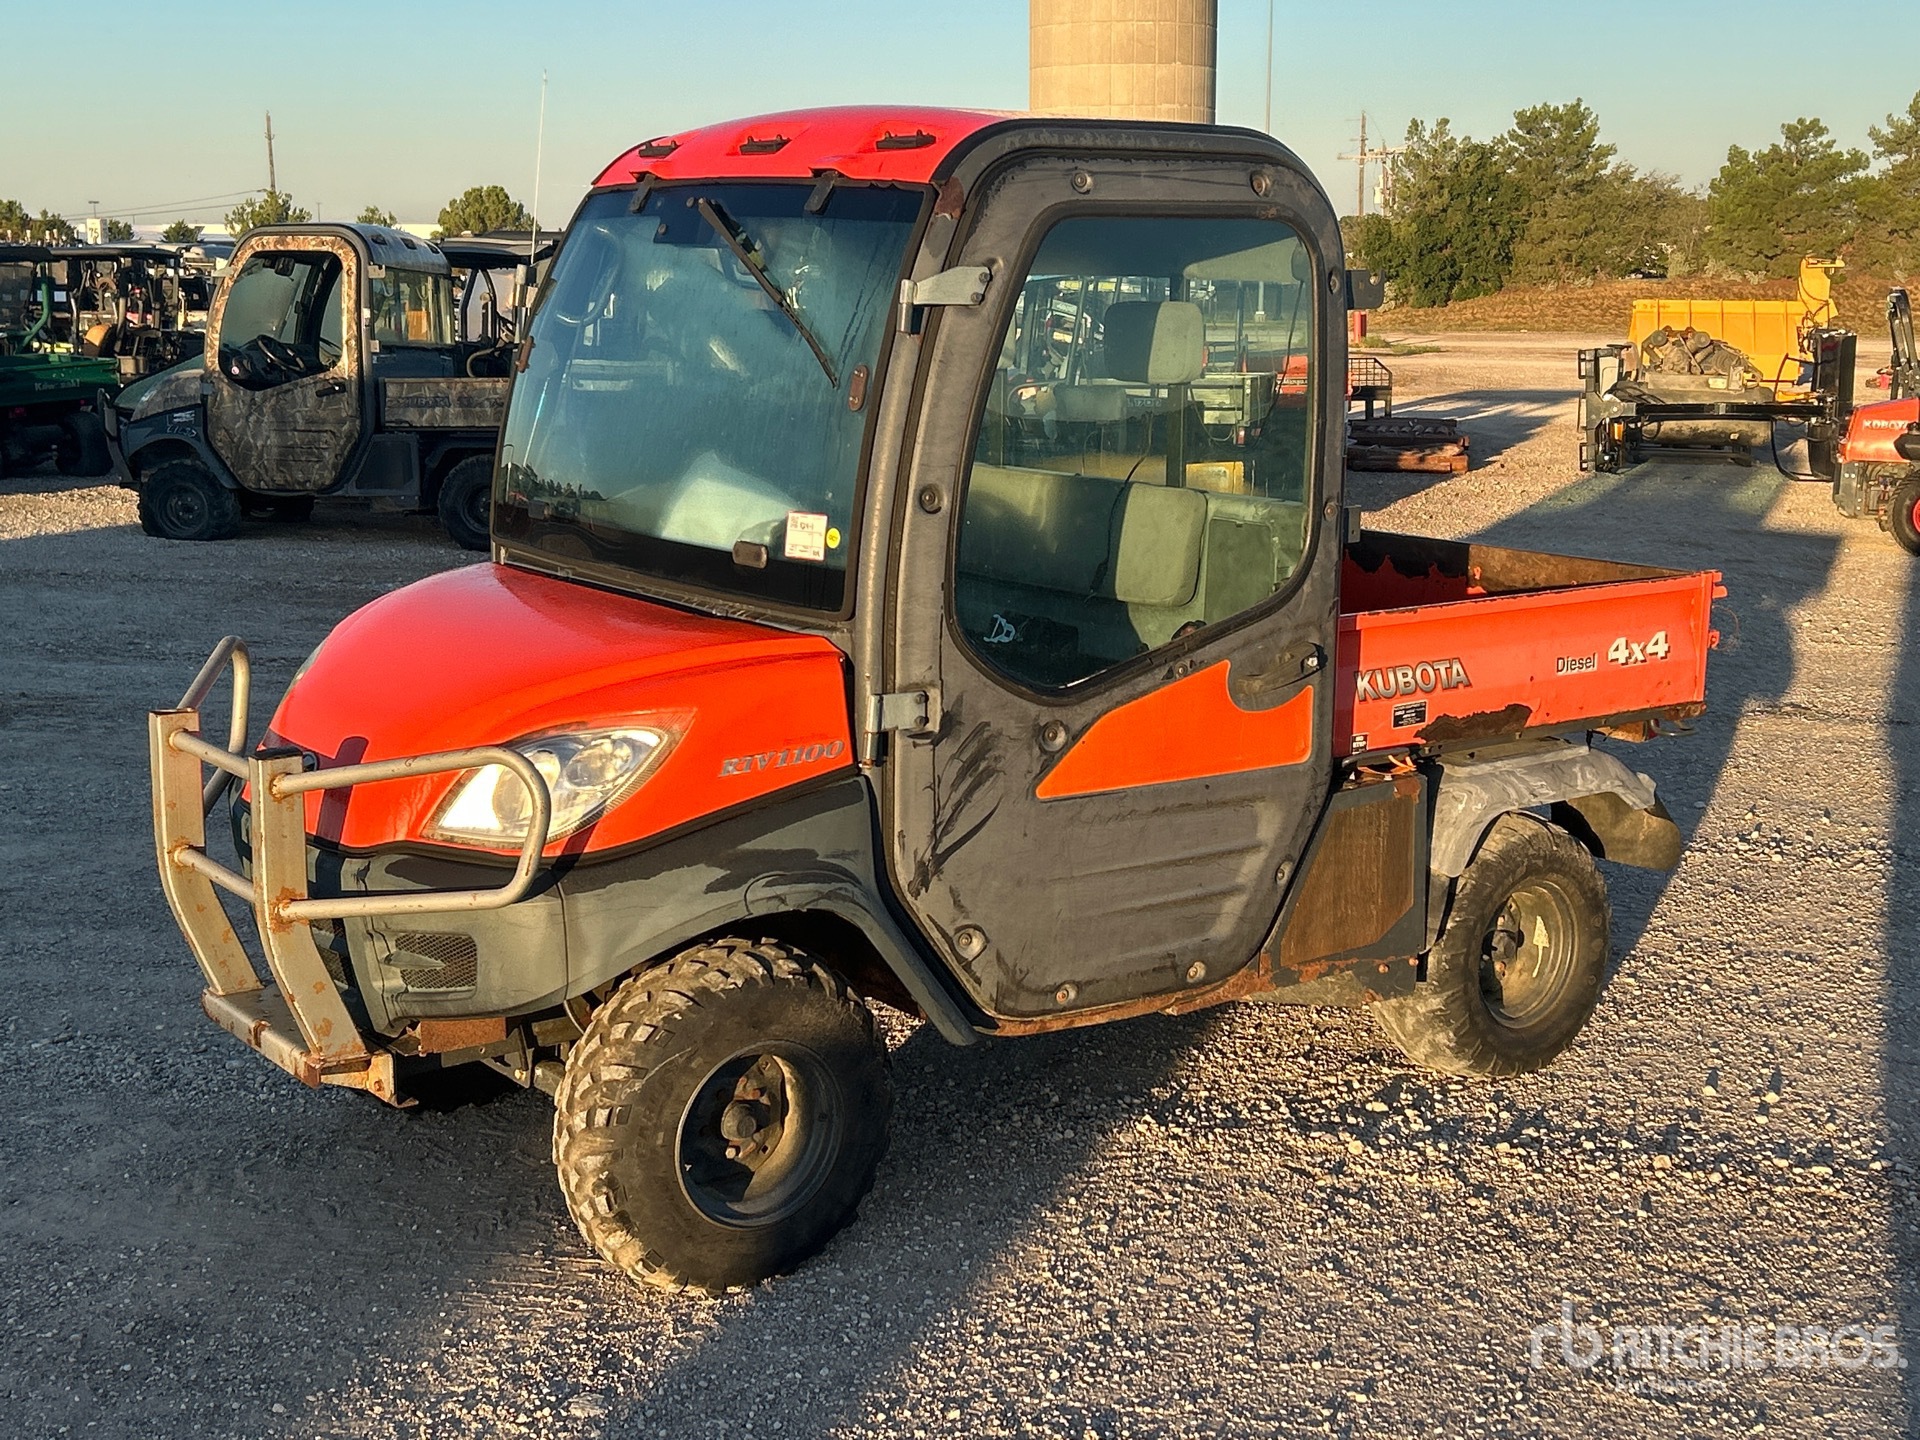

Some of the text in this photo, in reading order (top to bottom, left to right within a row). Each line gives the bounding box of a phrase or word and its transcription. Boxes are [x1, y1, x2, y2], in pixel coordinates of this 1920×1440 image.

[1556, 630, 1671, 673] Diesel 4x4
[1354, 657, 1473, 702] KUBOTA
[717, 739, 845, 778] RTV1100
